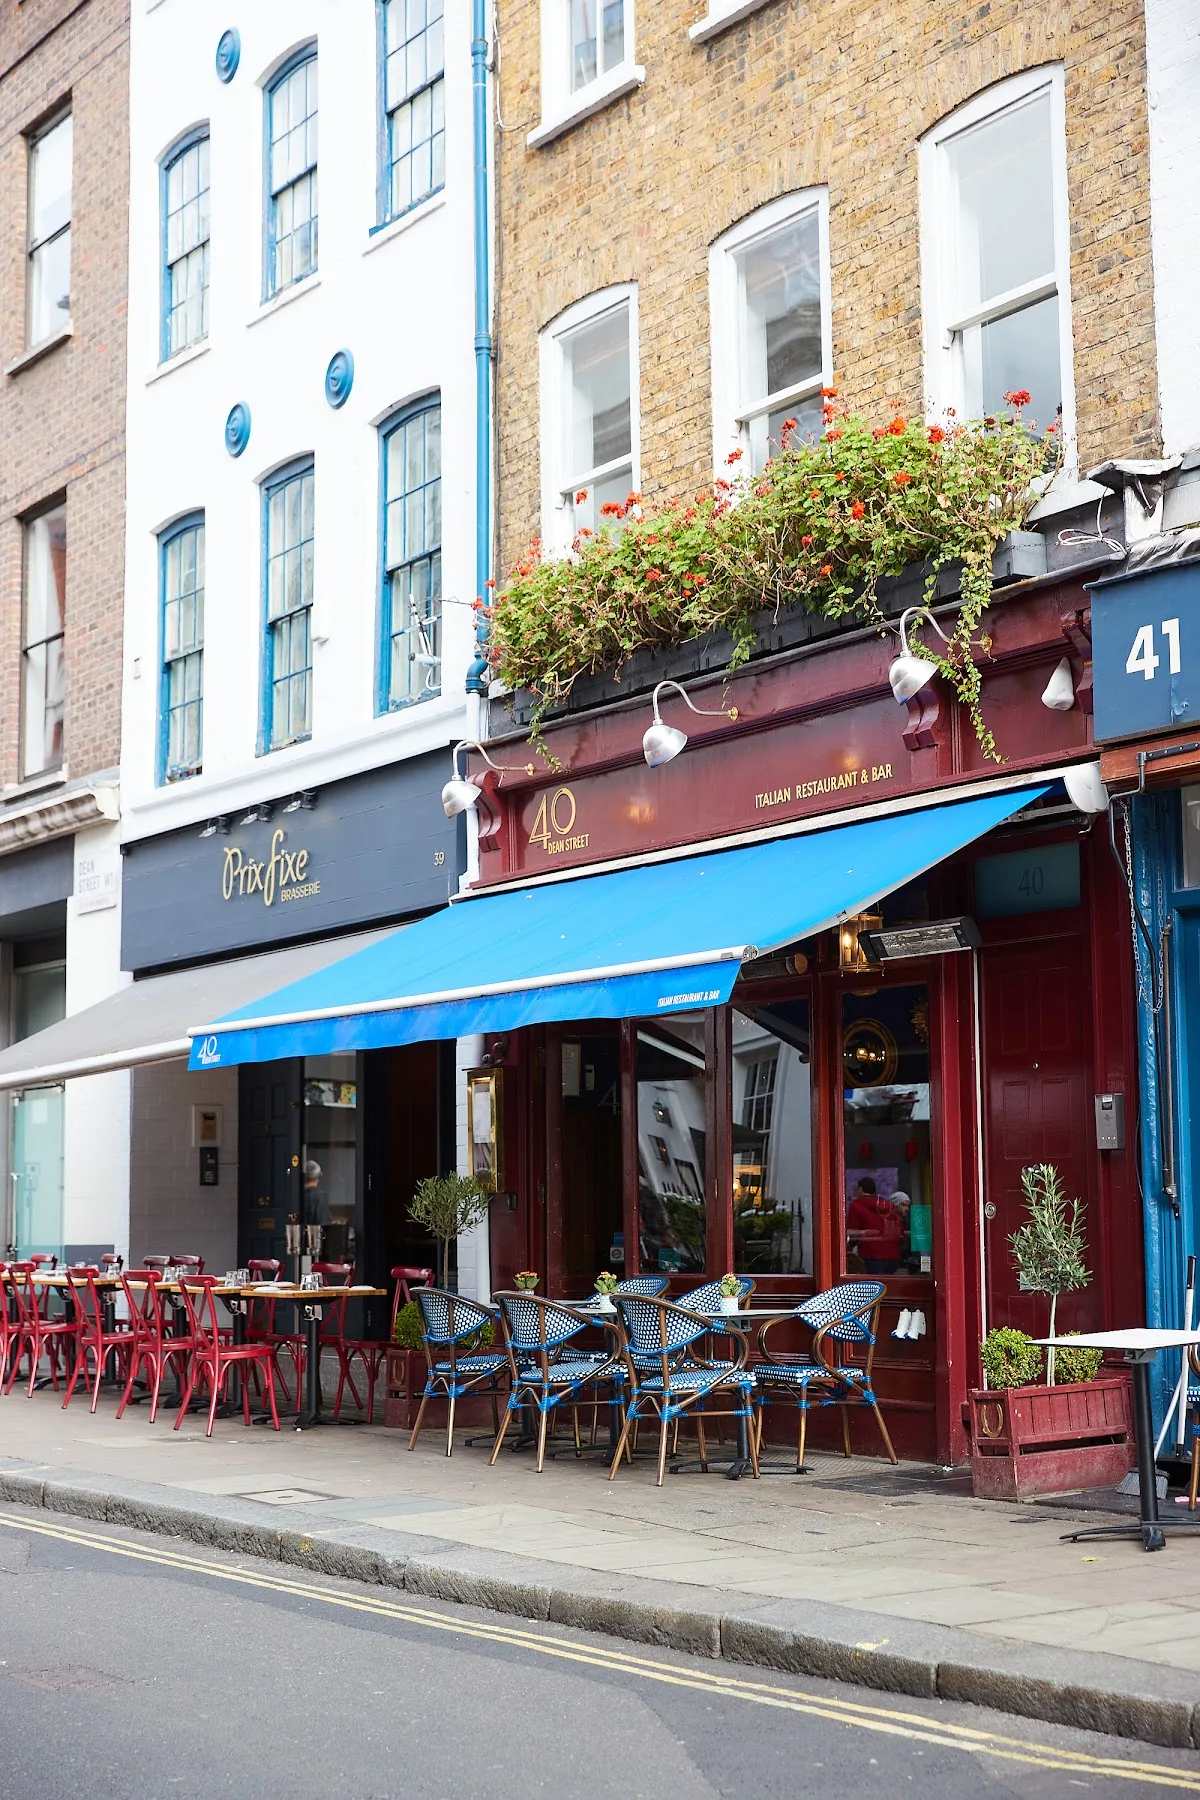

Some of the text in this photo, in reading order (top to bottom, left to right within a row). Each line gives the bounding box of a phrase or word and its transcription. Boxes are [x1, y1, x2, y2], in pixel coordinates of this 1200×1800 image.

[1125, 617, 1181, 681] 41
[755, 763, 893, 809] ITALIAN RESTAURANT & BAR
[528, 787, 577, 850] 40
[433, 851, 445, 866] 39
[548, 834, 590, 855] DEAN STREET
[280, 881, 321, 902] BRASSERIE
[1016, 866, 1044, 897] 40
[673, 991, 704, 1005] RESTAURANT
[709, 989, 720, 1001] BAR
[197, 1035, 218, 1065] 40
